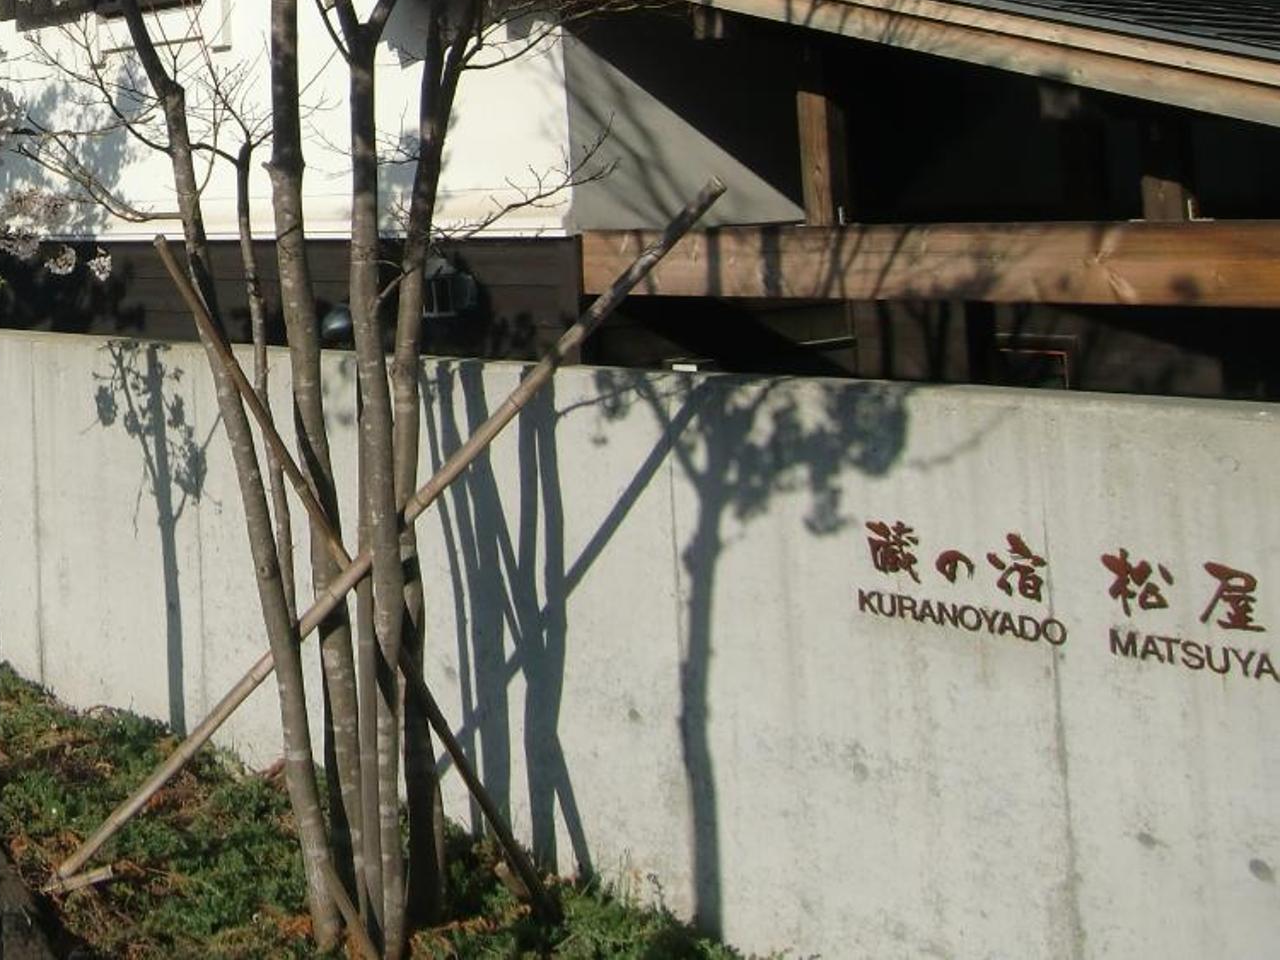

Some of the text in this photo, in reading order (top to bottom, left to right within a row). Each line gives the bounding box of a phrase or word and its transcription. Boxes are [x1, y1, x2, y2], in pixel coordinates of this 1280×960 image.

[1100, 547, 1267, 632] 松屋
[857, 588, 1280, 683] KURANOYADO MATSUYA
